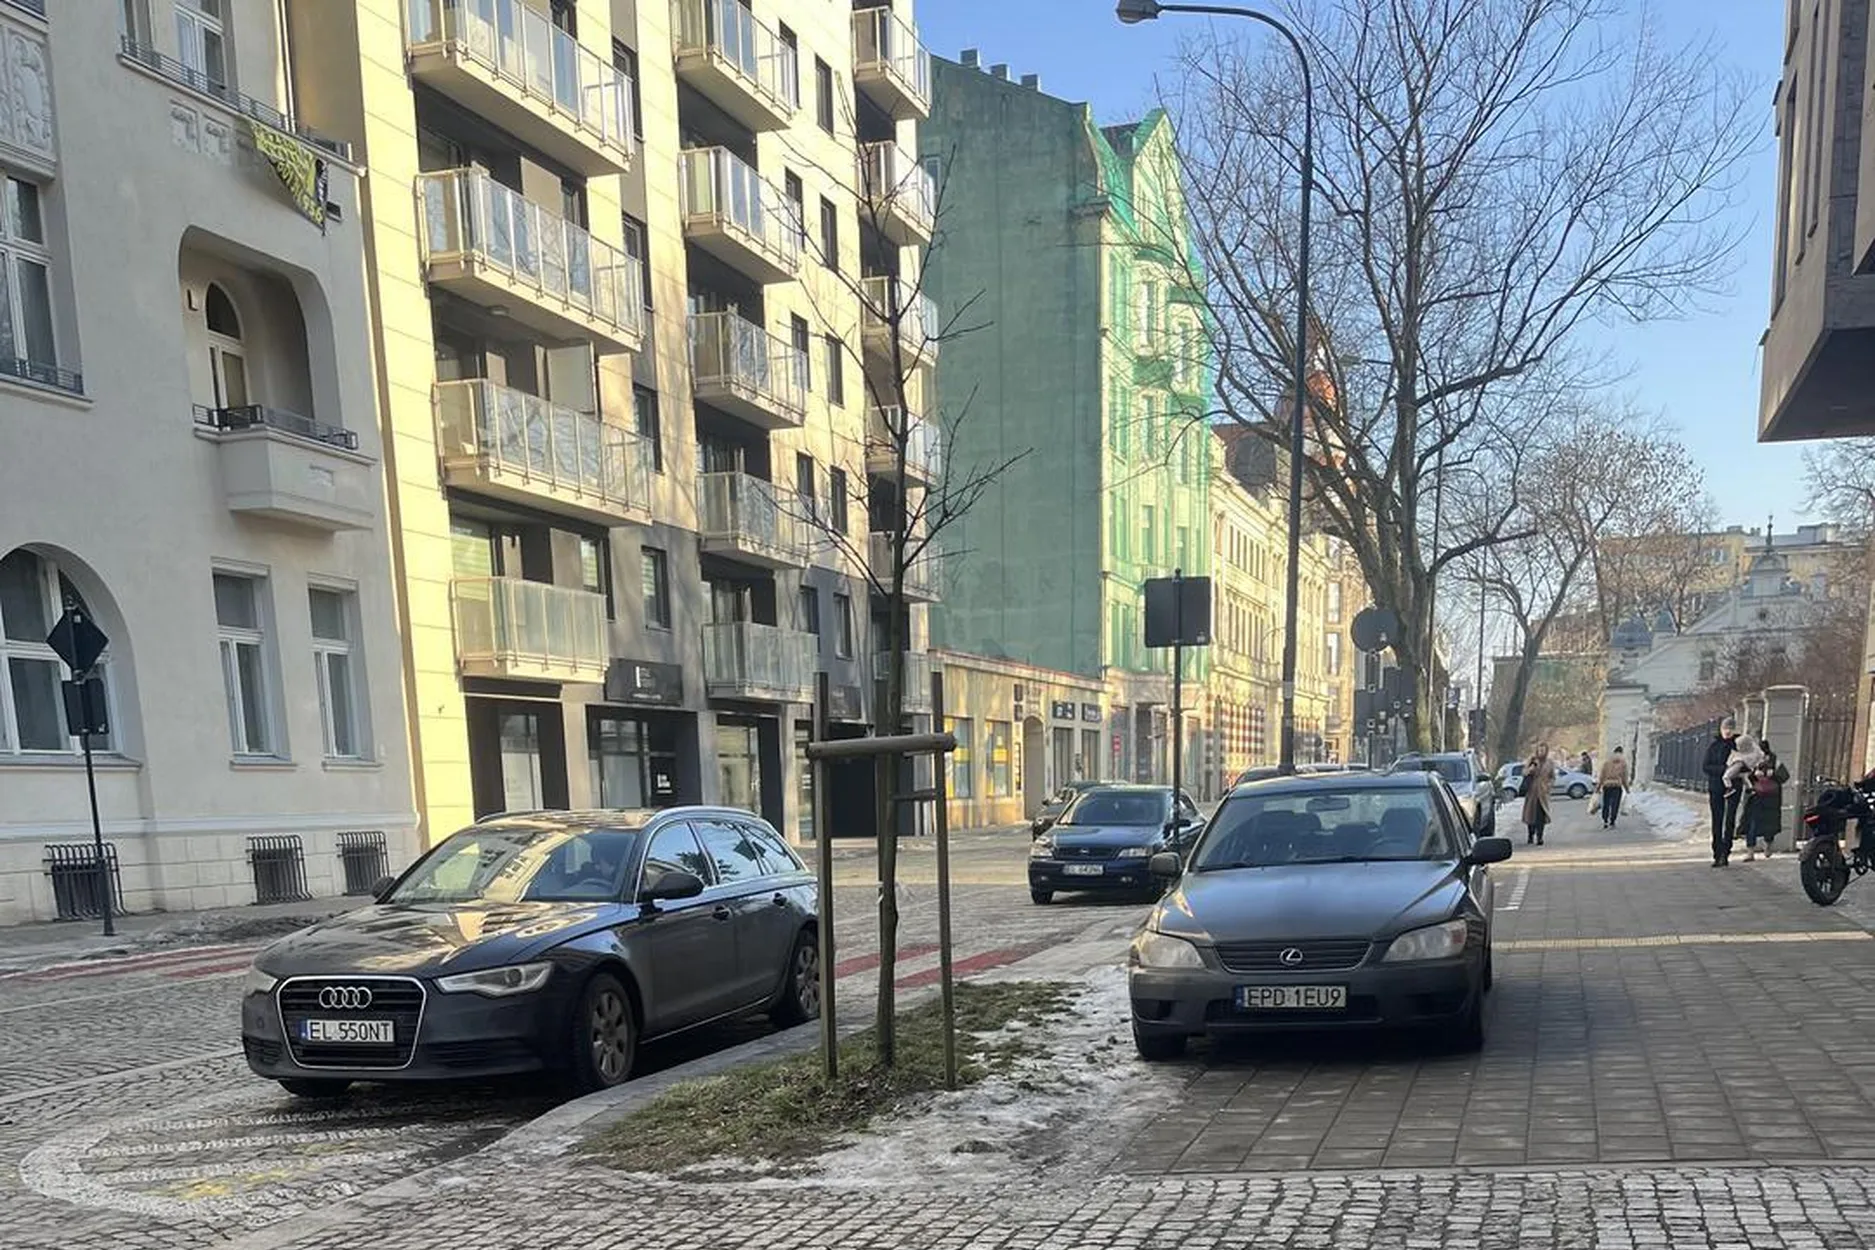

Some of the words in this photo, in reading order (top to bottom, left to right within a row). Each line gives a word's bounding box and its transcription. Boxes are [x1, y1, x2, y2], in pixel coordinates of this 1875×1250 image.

[1247, 988, 1286, 1006] EPD
[1294, 988, 1342, 1006] 1EU9
[309, 1021, 332, 1040] EL
[338, 1021, 390, 1041] 550NT
